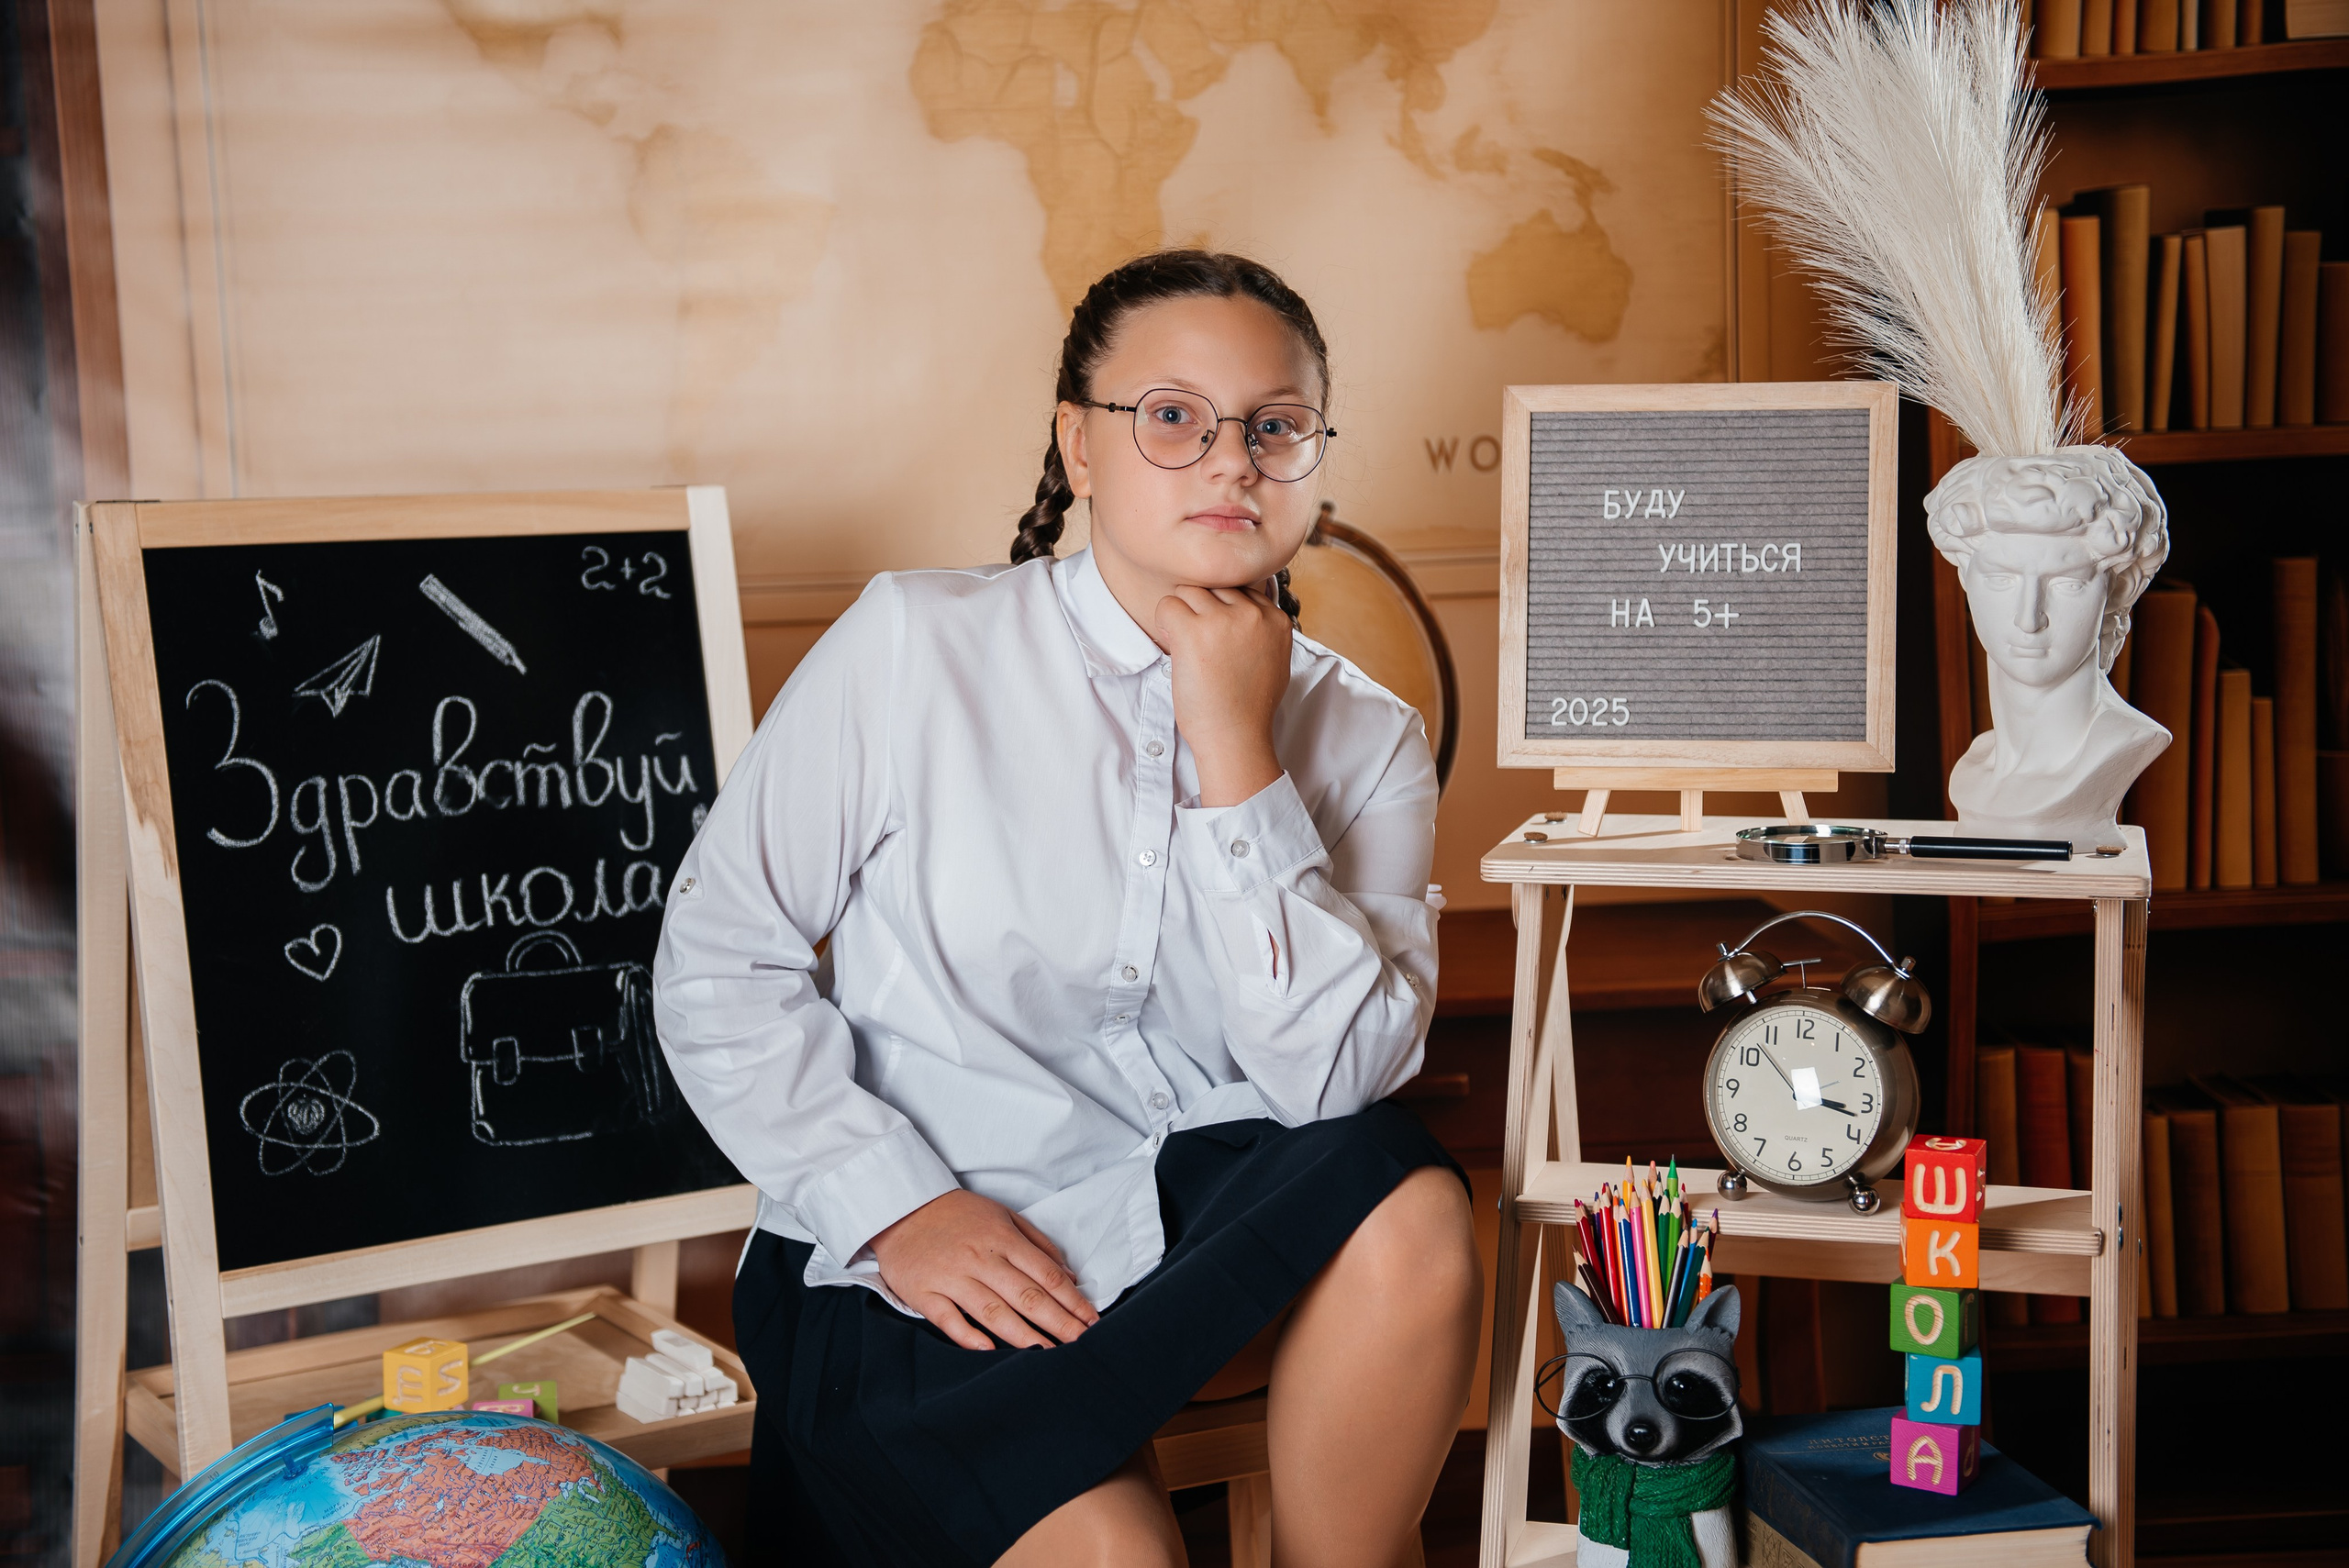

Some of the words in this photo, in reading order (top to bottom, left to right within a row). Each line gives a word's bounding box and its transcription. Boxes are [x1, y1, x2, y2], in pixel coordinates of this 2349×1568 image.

[1603, 489, 1687, 519] БУДУ
[1658, 542, 1802, 574] УЧИТЬСЯ
[581, 546, 671, 599] 2+2
[1610, 598, 1655, 628] НА
[1693, 599, 1741, 629] 5+
[1551, 696, 1631, 727] 2025
[185, 679, 697, 893] Здравствуй
[1765, 1025, 1778, 1045] 11
[1796, 1018, 1815, 1040] 12
[1835, 1032, 1840, 1052] 1
[1740, 1046, 1761, 1067] 10
[1853, 1057, 1865, 1078] 2
[1726, 1078, 1740, 1098] 9
[1861, 1093, 1874, 1114] 3
[1733, 1113, 1748, 1132] 8
[1846, 1124, 1861, 1144] 4
[1753, 1137, 1766, 1157] 7
[1820, 1148, 1834, 1167] 5
[1787, 1151, 1802, 1172] 6
